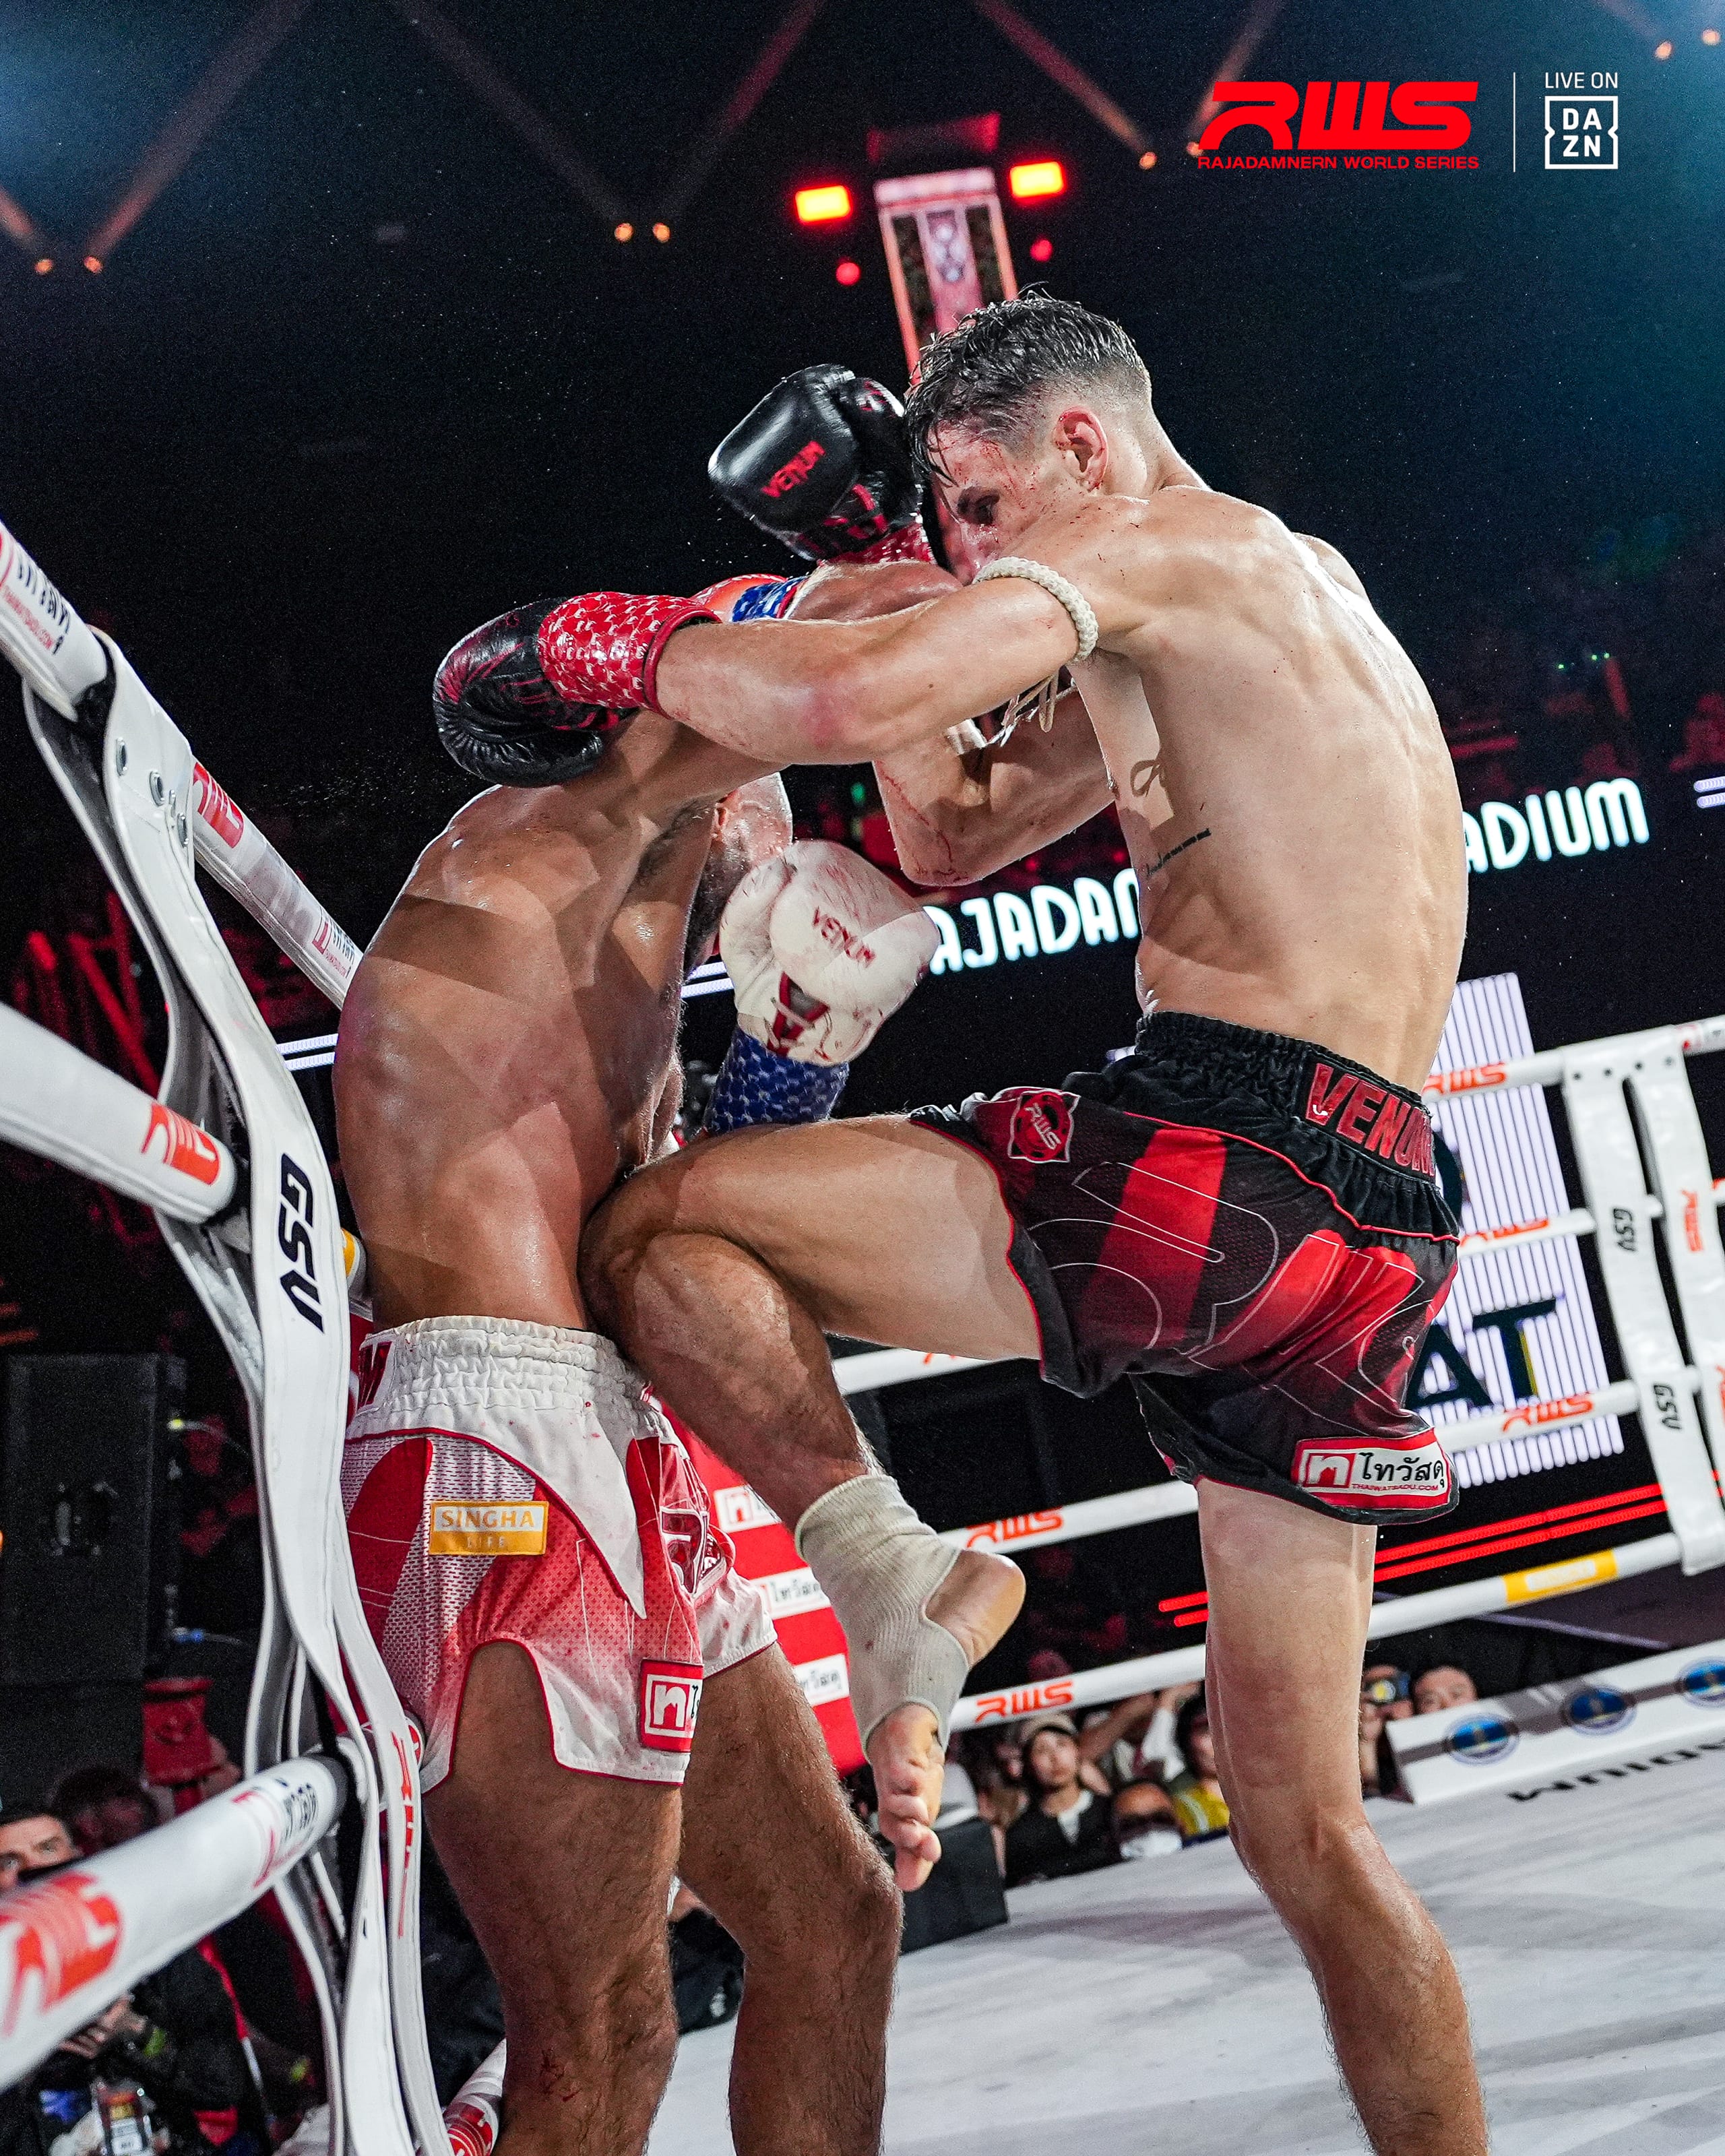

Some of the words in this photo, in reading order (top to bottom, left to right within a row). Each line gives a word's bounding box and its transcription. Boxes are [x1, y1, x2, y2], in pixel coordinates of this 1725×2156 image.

[1024, 1102, 1063, 1150] RWS
[278, 1153, 325, 1333] GSV
[1358, 1452, 1445, 1488] ไทวัสดุ
[441, 1510, 534, 1529] SINGHA
[975, 1680, 1073, 1723] RWS
